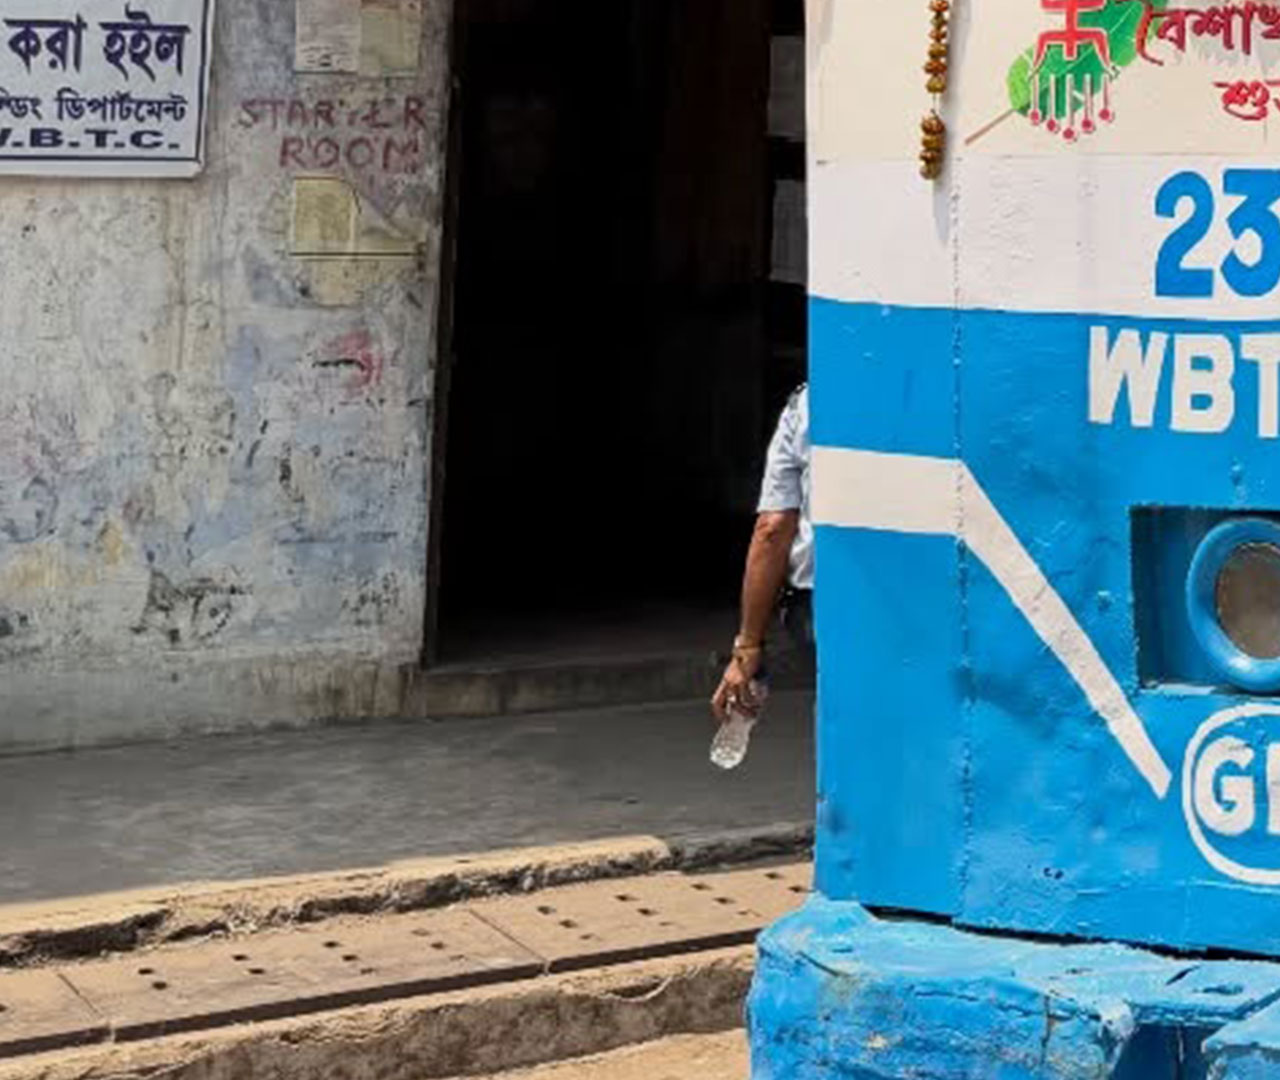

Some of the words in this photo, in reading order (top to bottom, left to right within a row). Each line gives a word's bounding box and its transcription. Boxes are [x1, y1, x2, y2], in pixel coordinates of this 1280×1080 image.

[4, 13, 87, 73] করা
[99, 1, 191, 82] হইল
[279, 136, 420, 173] ROOM
